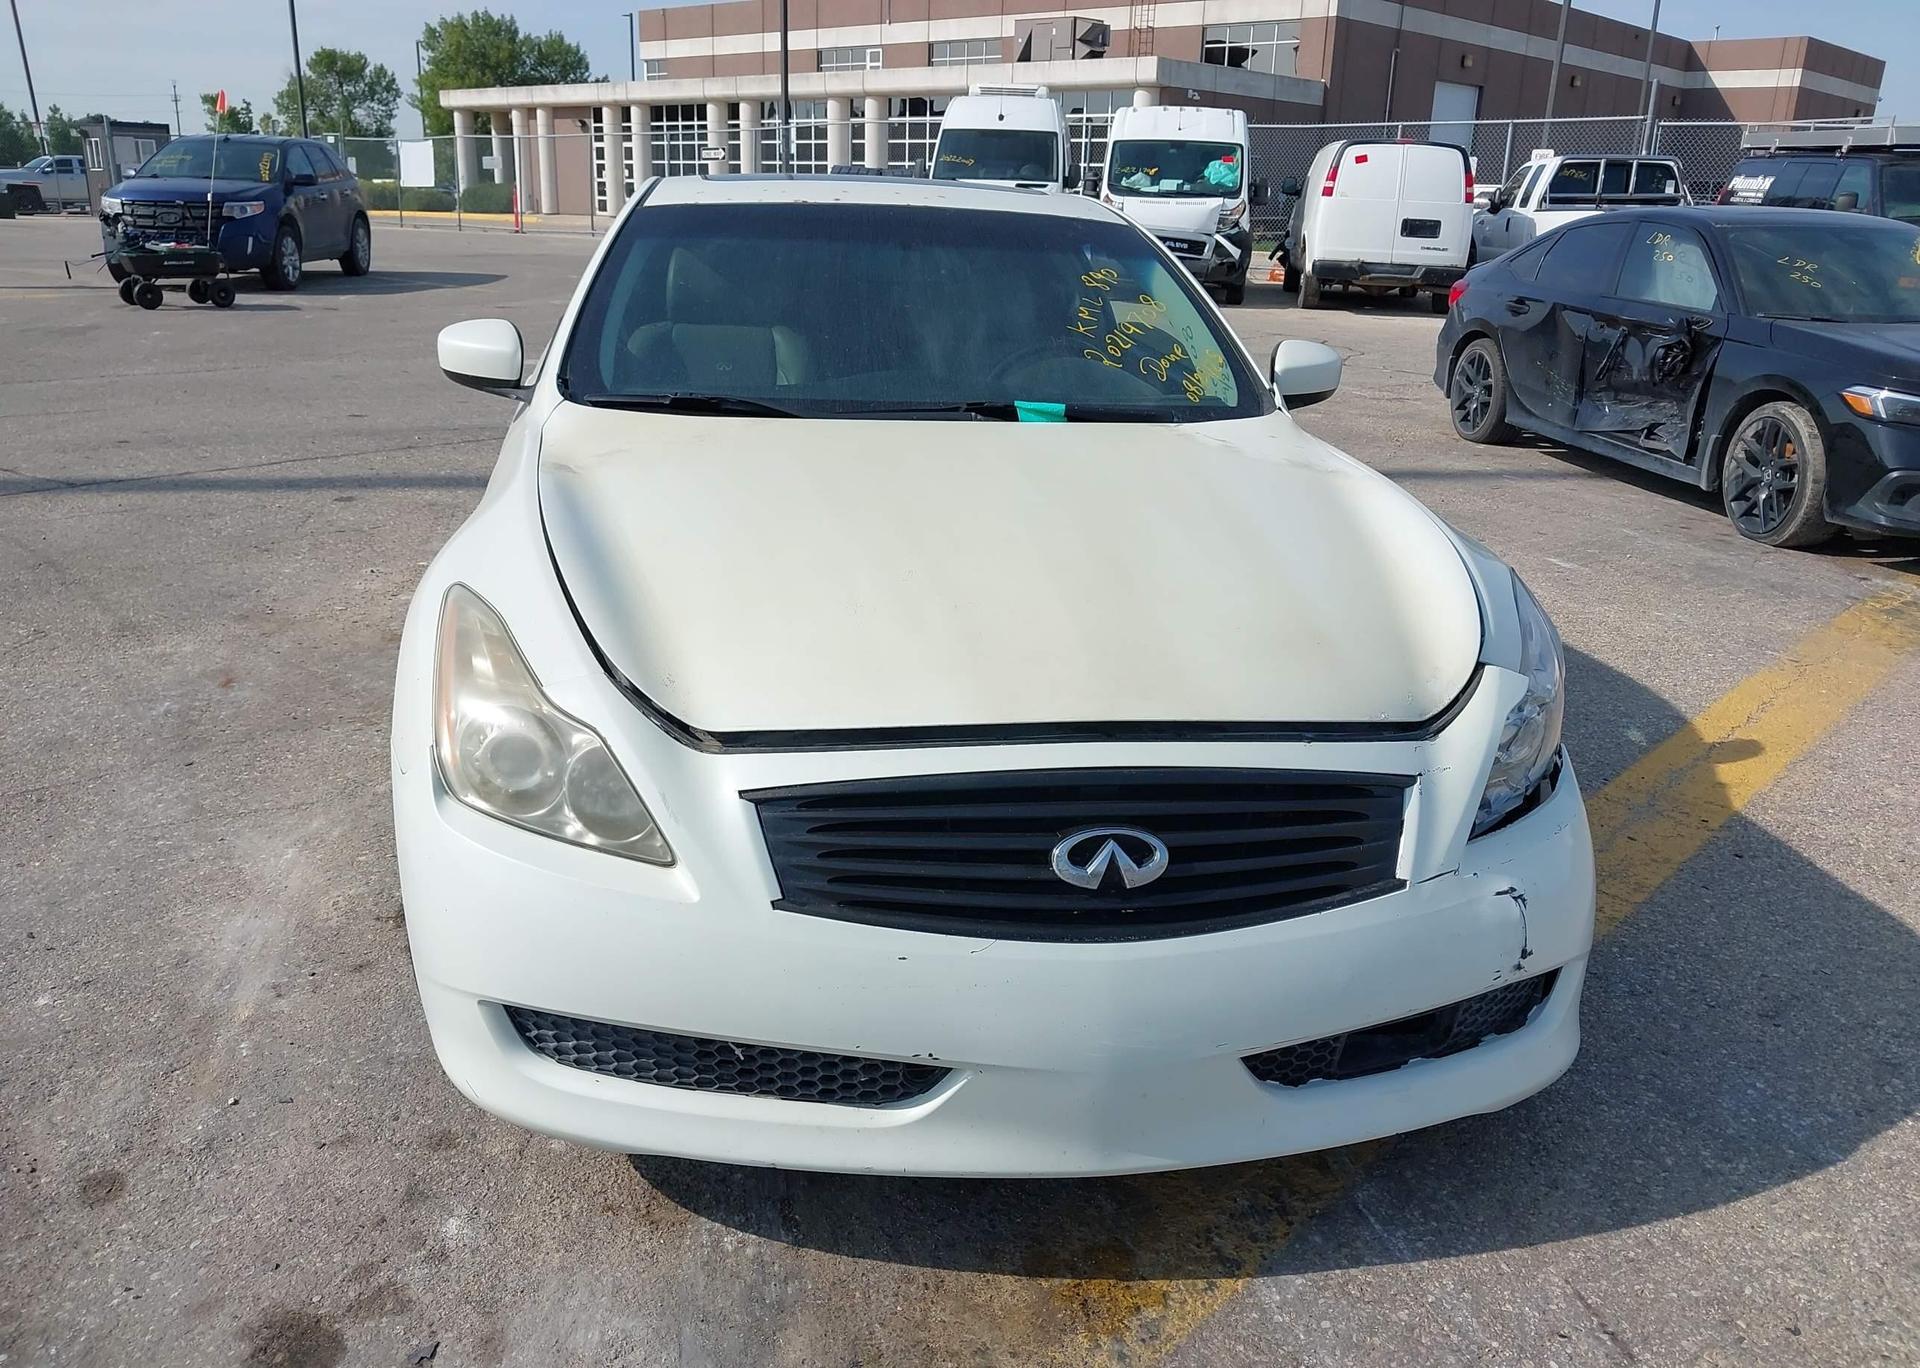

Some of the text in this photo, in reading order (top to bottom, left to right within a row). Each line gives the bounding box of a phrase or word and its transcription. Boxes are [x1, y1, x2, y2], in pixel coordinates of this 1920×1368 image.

[1646, 231, 1671, 247] LDR
[1653, 249, 1674, 262] 250
[1777, 256, 1819, 273] LDR
[1789, 271, 1822, 289] 250
[1066, 268, 1119, 338] KML 890
[1139, 343, 1190, 382] Done
